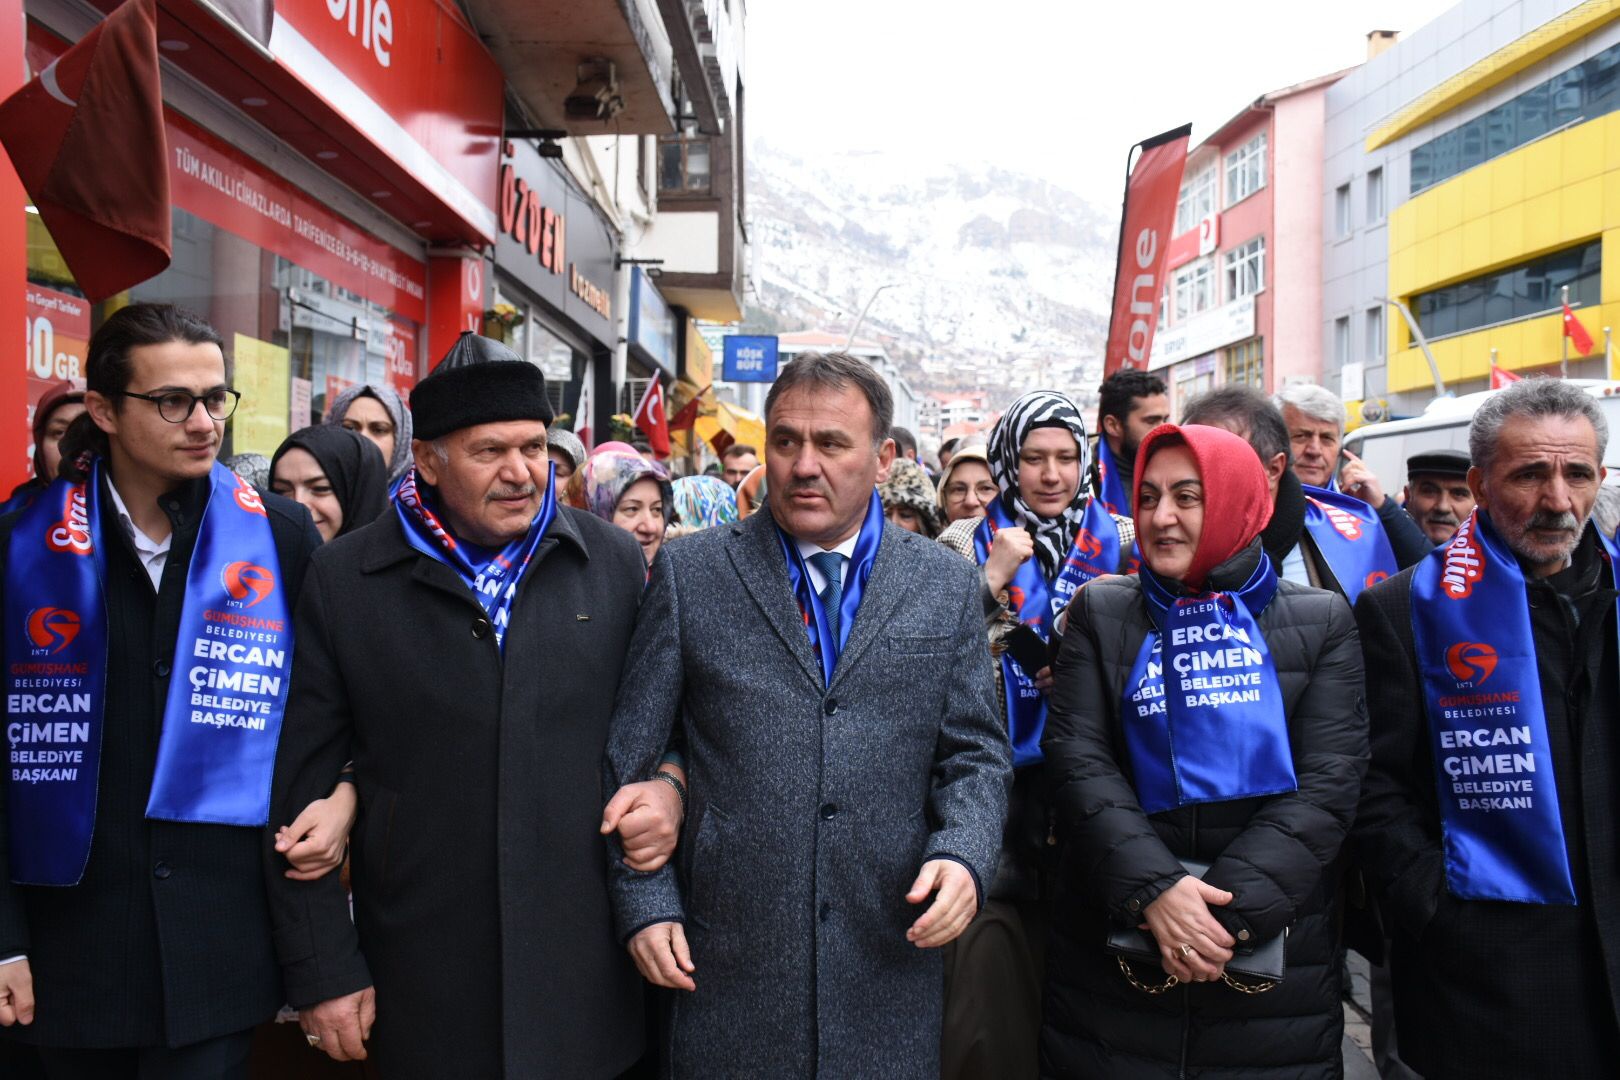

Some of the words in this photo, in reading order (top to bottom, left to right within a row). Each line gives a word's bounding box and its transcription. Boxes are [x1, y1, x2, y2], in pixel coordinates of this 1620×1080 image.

[175, 147, 200, 179] TÜM
[201, 164, 235, 198] AKILLI
[235, 180, 292, 228] CİHAZLARDA
[502, 140, 565, 275] ÖZDEN
[736, 359, 763, 371] BÜFE
[202, 609, 285, 632] GÜMÜŞHANE
[194, 638, 285, 669] ERCAN
[11, 662, 89, 675] GÜMÜŞHANE
[7, 693, 91, 713] ERCAN
[1185, 689, 1261, 709] BAŞKANI
[1439, 690, 1521, 708] GÜMÜŞHANE
[191, 710, 266, 731] BAŞKANI
[1440, 726, 1532, 749] ERCAN
[12, 768, 78, 785] BAŞKANI
[1458, 796, 1533, 813] BAŞKANI
